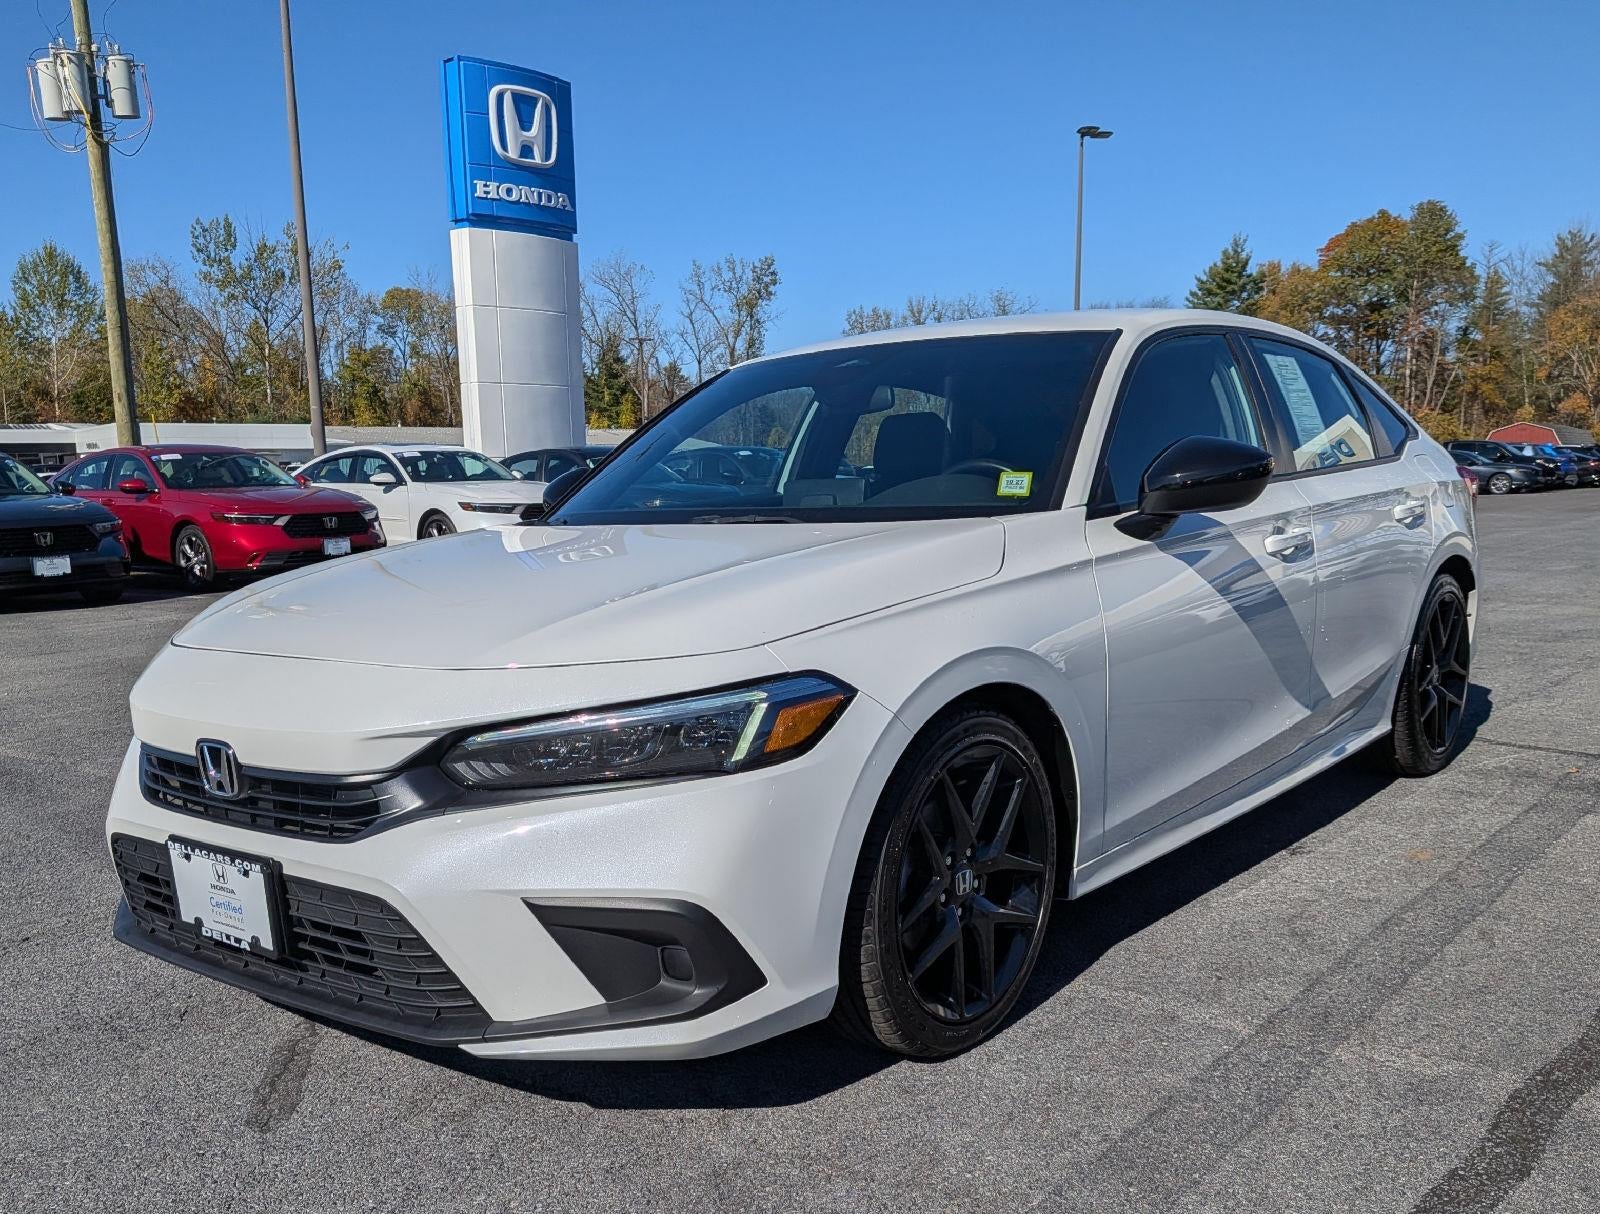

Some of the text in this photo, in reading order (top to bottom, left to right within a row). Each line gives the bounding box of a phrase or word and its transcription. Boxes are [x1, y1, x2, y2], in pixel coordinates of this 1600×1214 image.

[473, 180, 574, 211] HONDA
[167, 840, 261, 873] DELLACARS.COM
[209, 883, 236, 895] HONDA
[209, 896, 243, 915] Certified
[201, 926, 251, 951] DELLA
